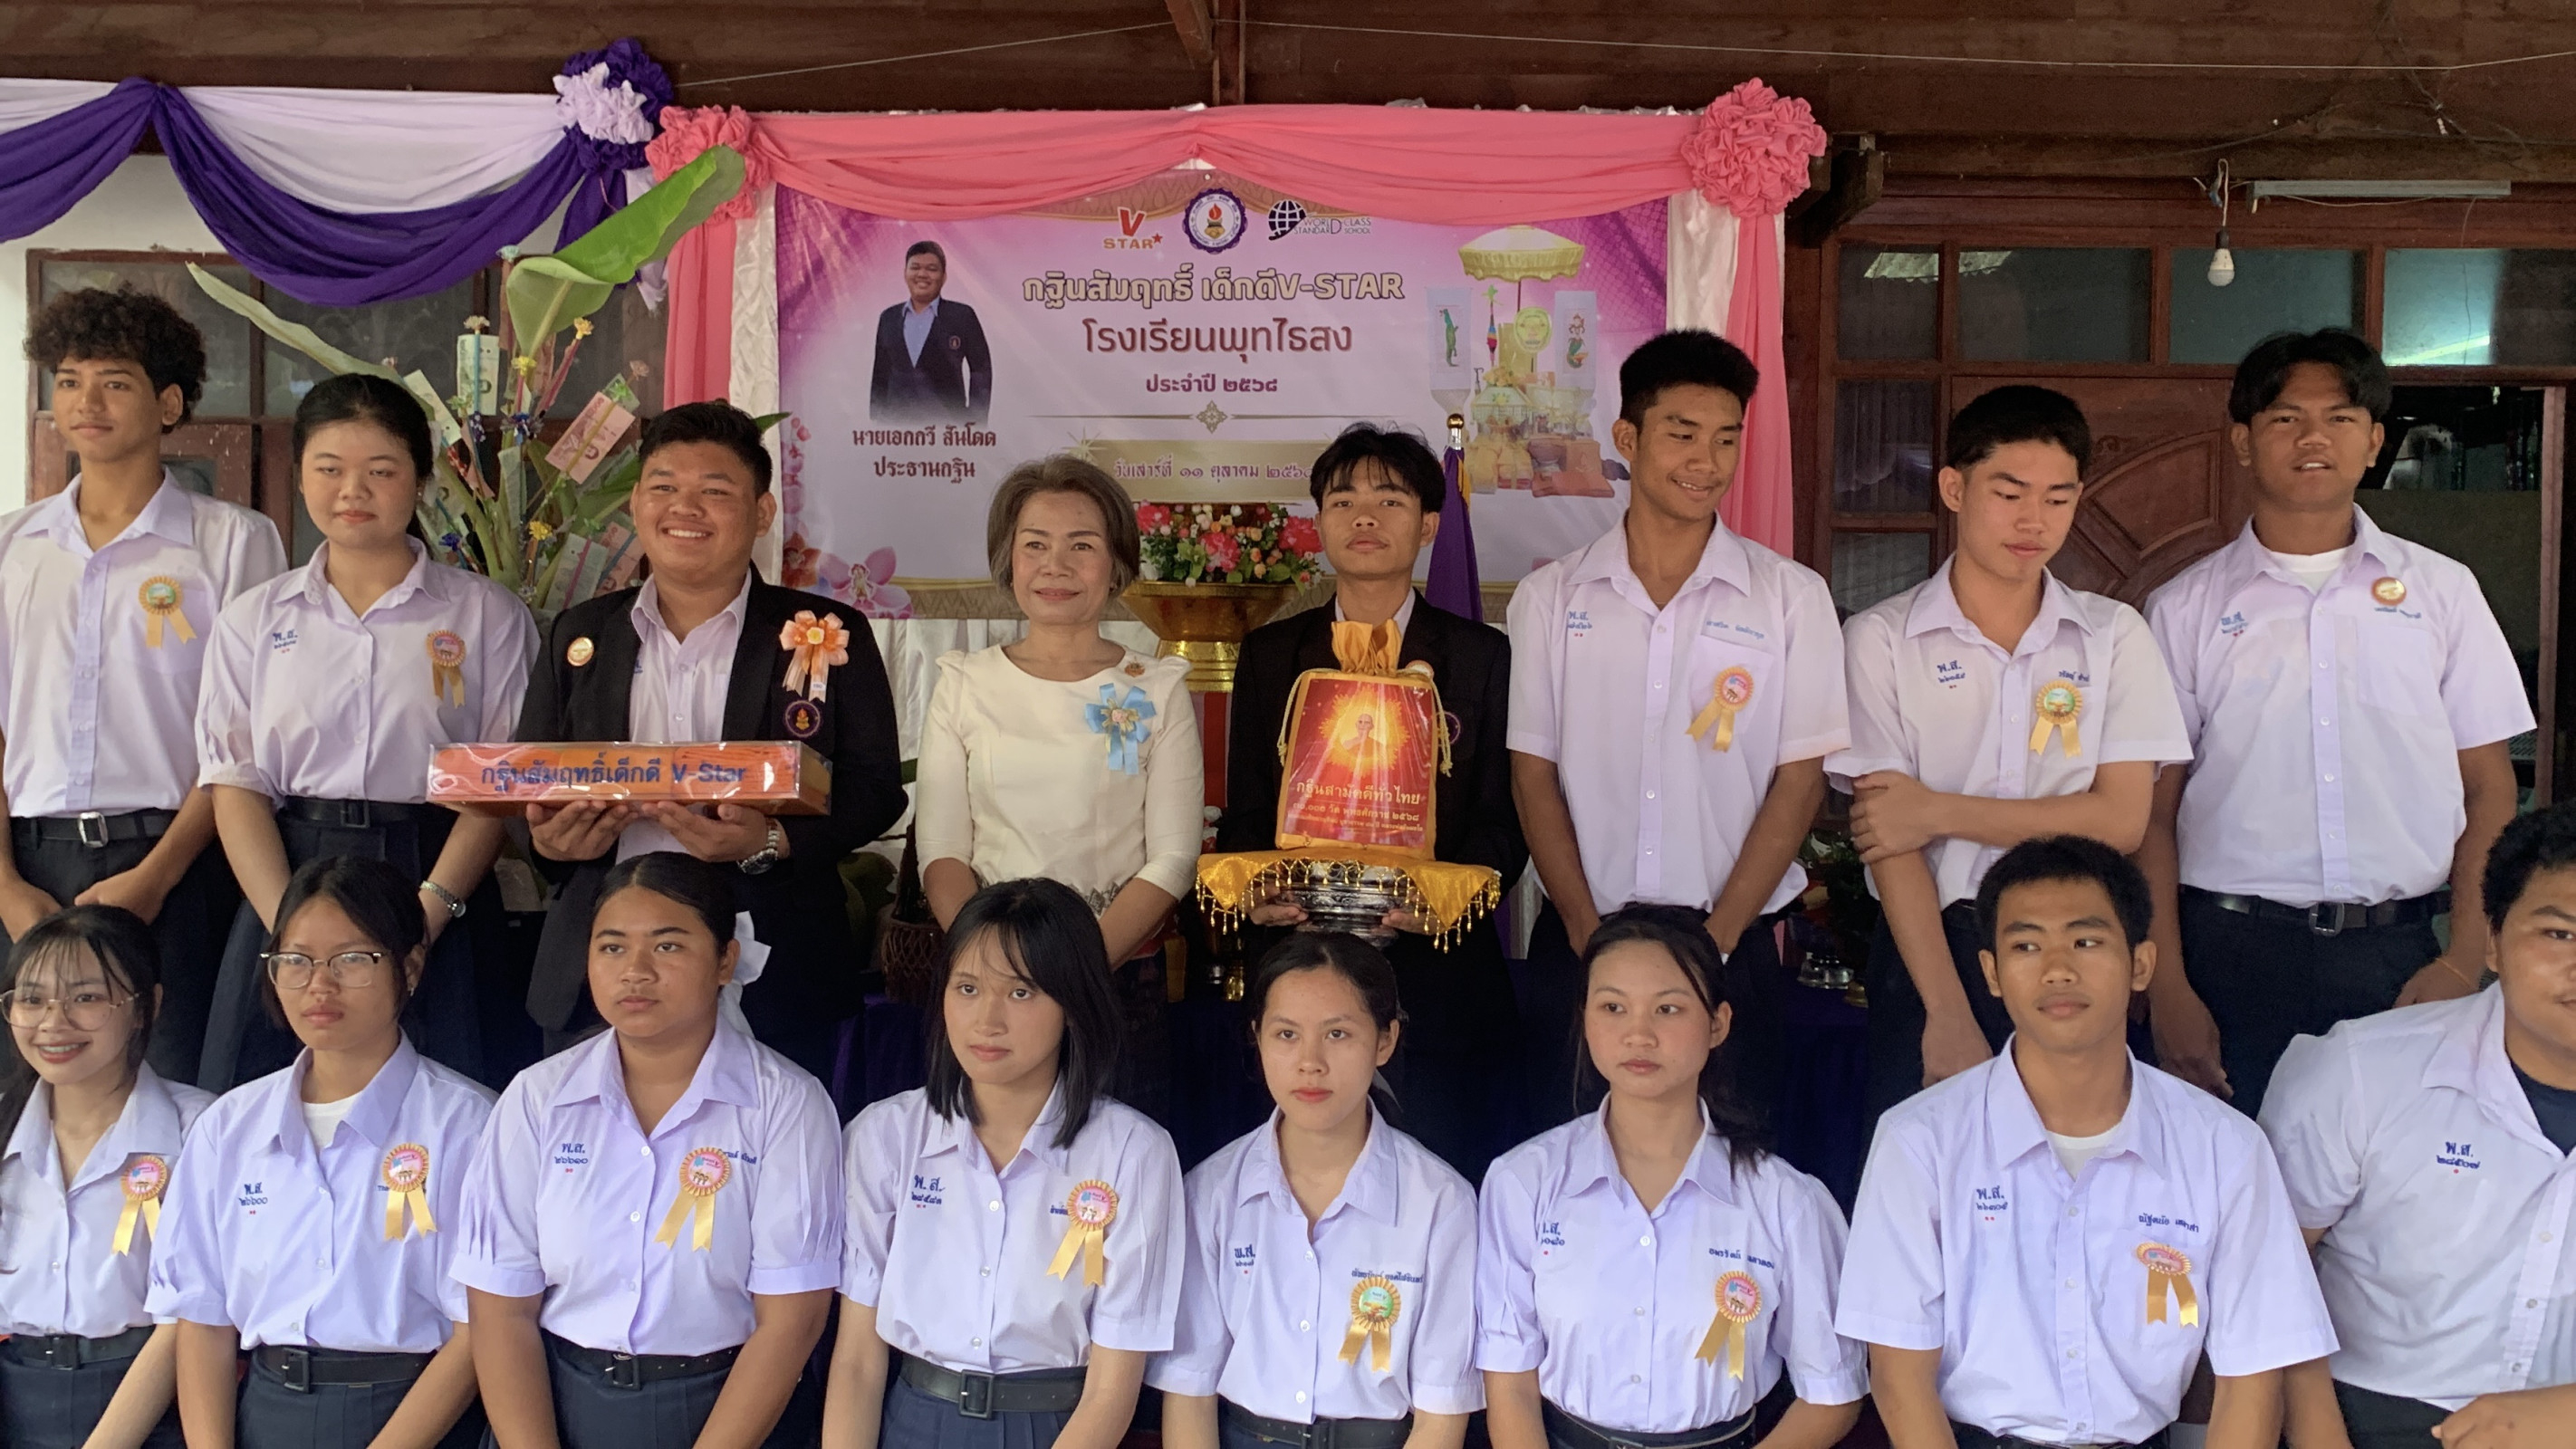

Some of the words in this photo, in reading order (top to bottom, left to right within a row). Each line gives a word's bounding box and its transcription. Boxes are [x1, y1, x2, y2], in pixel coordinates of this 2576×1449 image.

[1120, 208, 1145, 237] V
[1104, 238, 1153, 249] STAR
[1023, 264, 1193, 309] กฐินสัมฤทธิ์
[1082, 317, 1352, 363] โรงเรียนพุทไธสง
[1146, 373, 1216, 393] ประจำปี
[1223, 377, 1278, 393] ๒๕๖๘
[874, 456, 975, 484] ประธานกฐิน
[1179, 466, 1204, 478] ๑๑
[1210, 465, 1259, 483] ตุลาคม
